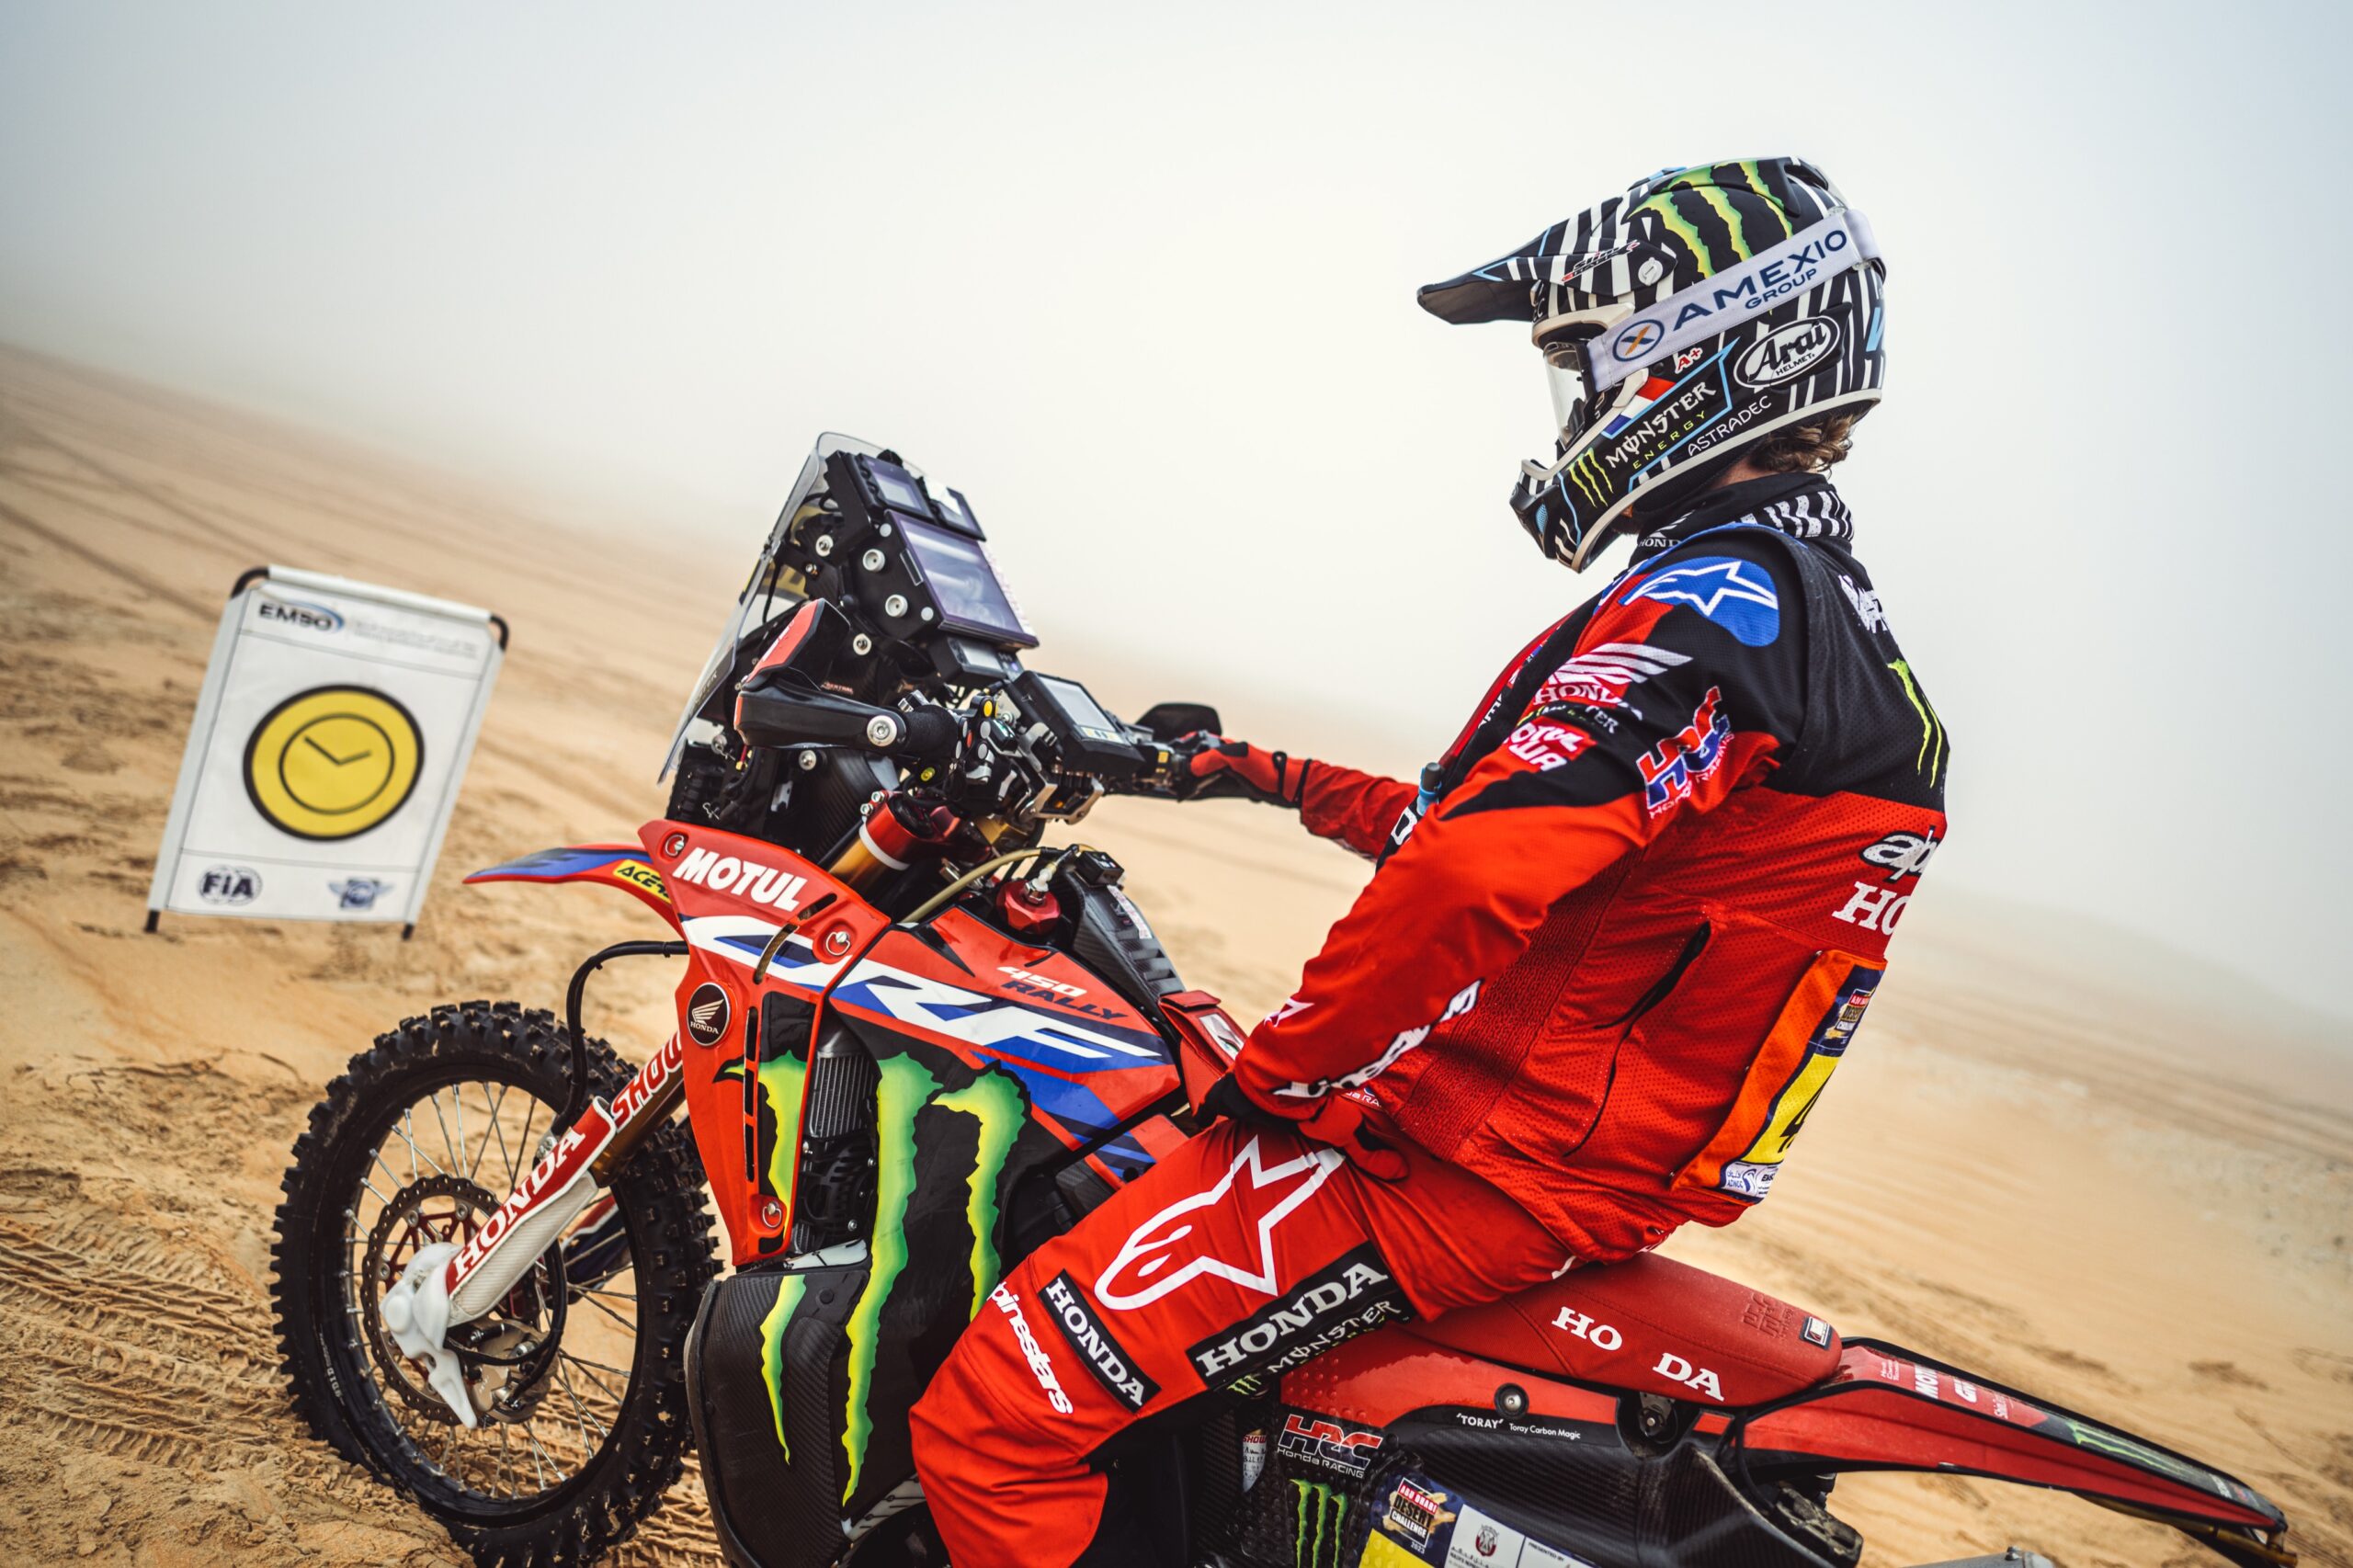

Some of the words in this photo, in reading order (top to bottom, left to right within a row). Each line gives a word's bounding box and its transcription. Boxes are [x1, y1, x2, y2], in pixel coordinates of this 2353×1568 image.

[1673, 230, 1847, 331] AMEXIO
[1745, 267, 1817, 310] GROUP
[1745, 321, 1827, 382] Arai
[1632, 410, 1707, 470] ENERGY
[1688, 395, 1773, 457] ASTRADEC
[1639, 538, 1682, 548] HOND
[201, 871, 255, 898] FIA
[672, 846, 808, 913] MOTUL
[996, 965, 1088, 998] 450
[1000, 980, 1129, 1021] RALLY
[689, 1019, 720, 1036] HONDA
[453, 1127, 586, 1283] HONDA
[1196, 1262, 1389, 1378] HONDA
[985, 1280, 1074, 1415] pinestars
[1046, 1277, 1149, 1407] HONDA
[1242, 1435, 1267, 1444] SHOW
[1278, 1413, 1384, 1471] HRC
[1509, 1423, 1529, 1435] Toray
[1529, 1425, 1557, 1437] Carbon
[1557, 1427, 1582, 1441] Magic
[1277, 1446, 1320, 1465] Honda
[1322, 1459, 1365, 1479] RACING
[1394, 1495, 1435, 1528] DESERT
[1400, 1484, 1415, 1500] ABU
[1415, 1494, 1438, 1514] DHABI
[1391, 1509, 1428, 1540] CHALLENGE
[1410, 1540, 1426, 1555] 2023
